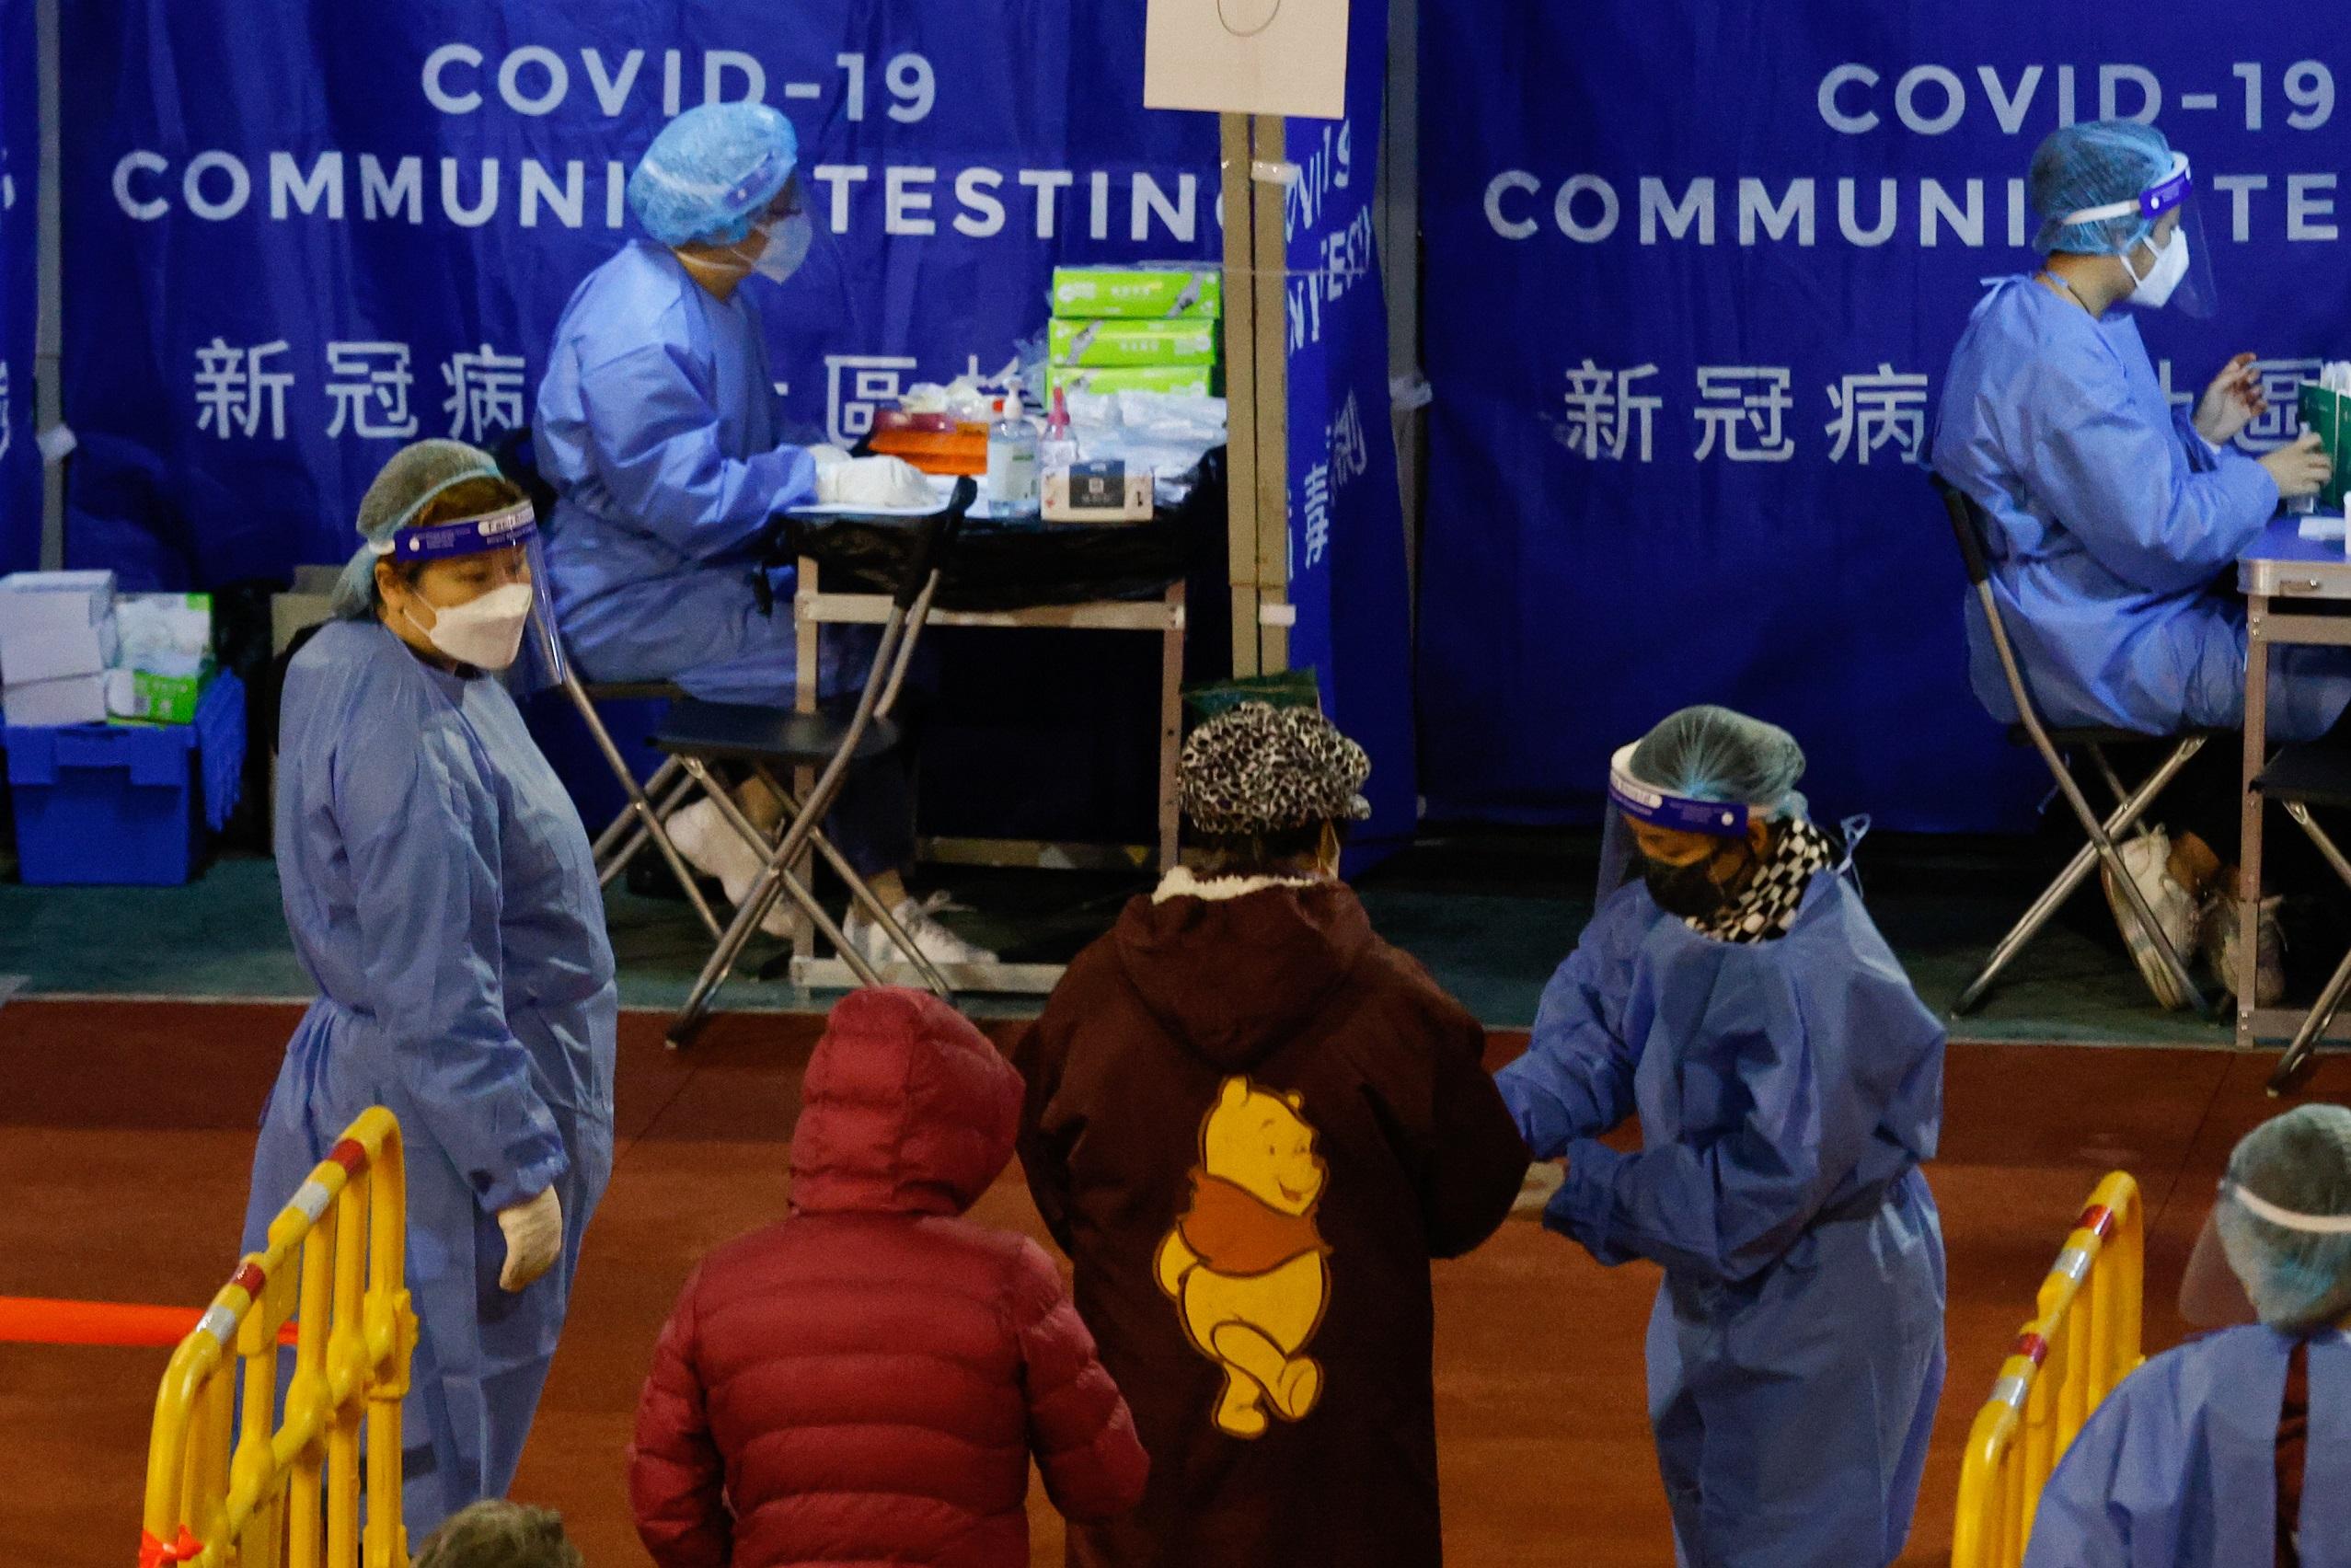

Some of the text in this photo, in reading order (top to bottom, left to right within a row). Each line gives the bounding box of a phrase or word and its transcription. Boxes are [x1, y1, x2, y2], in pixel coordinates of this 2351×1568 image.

[421, 42, 937, 123] COVID-19
[1817, 59, 2337, 135] COVID-19
[111, 149, 1224, 243] COMMUNI TESTIN
[1483, 169, 2025, 247] COMMUNI
